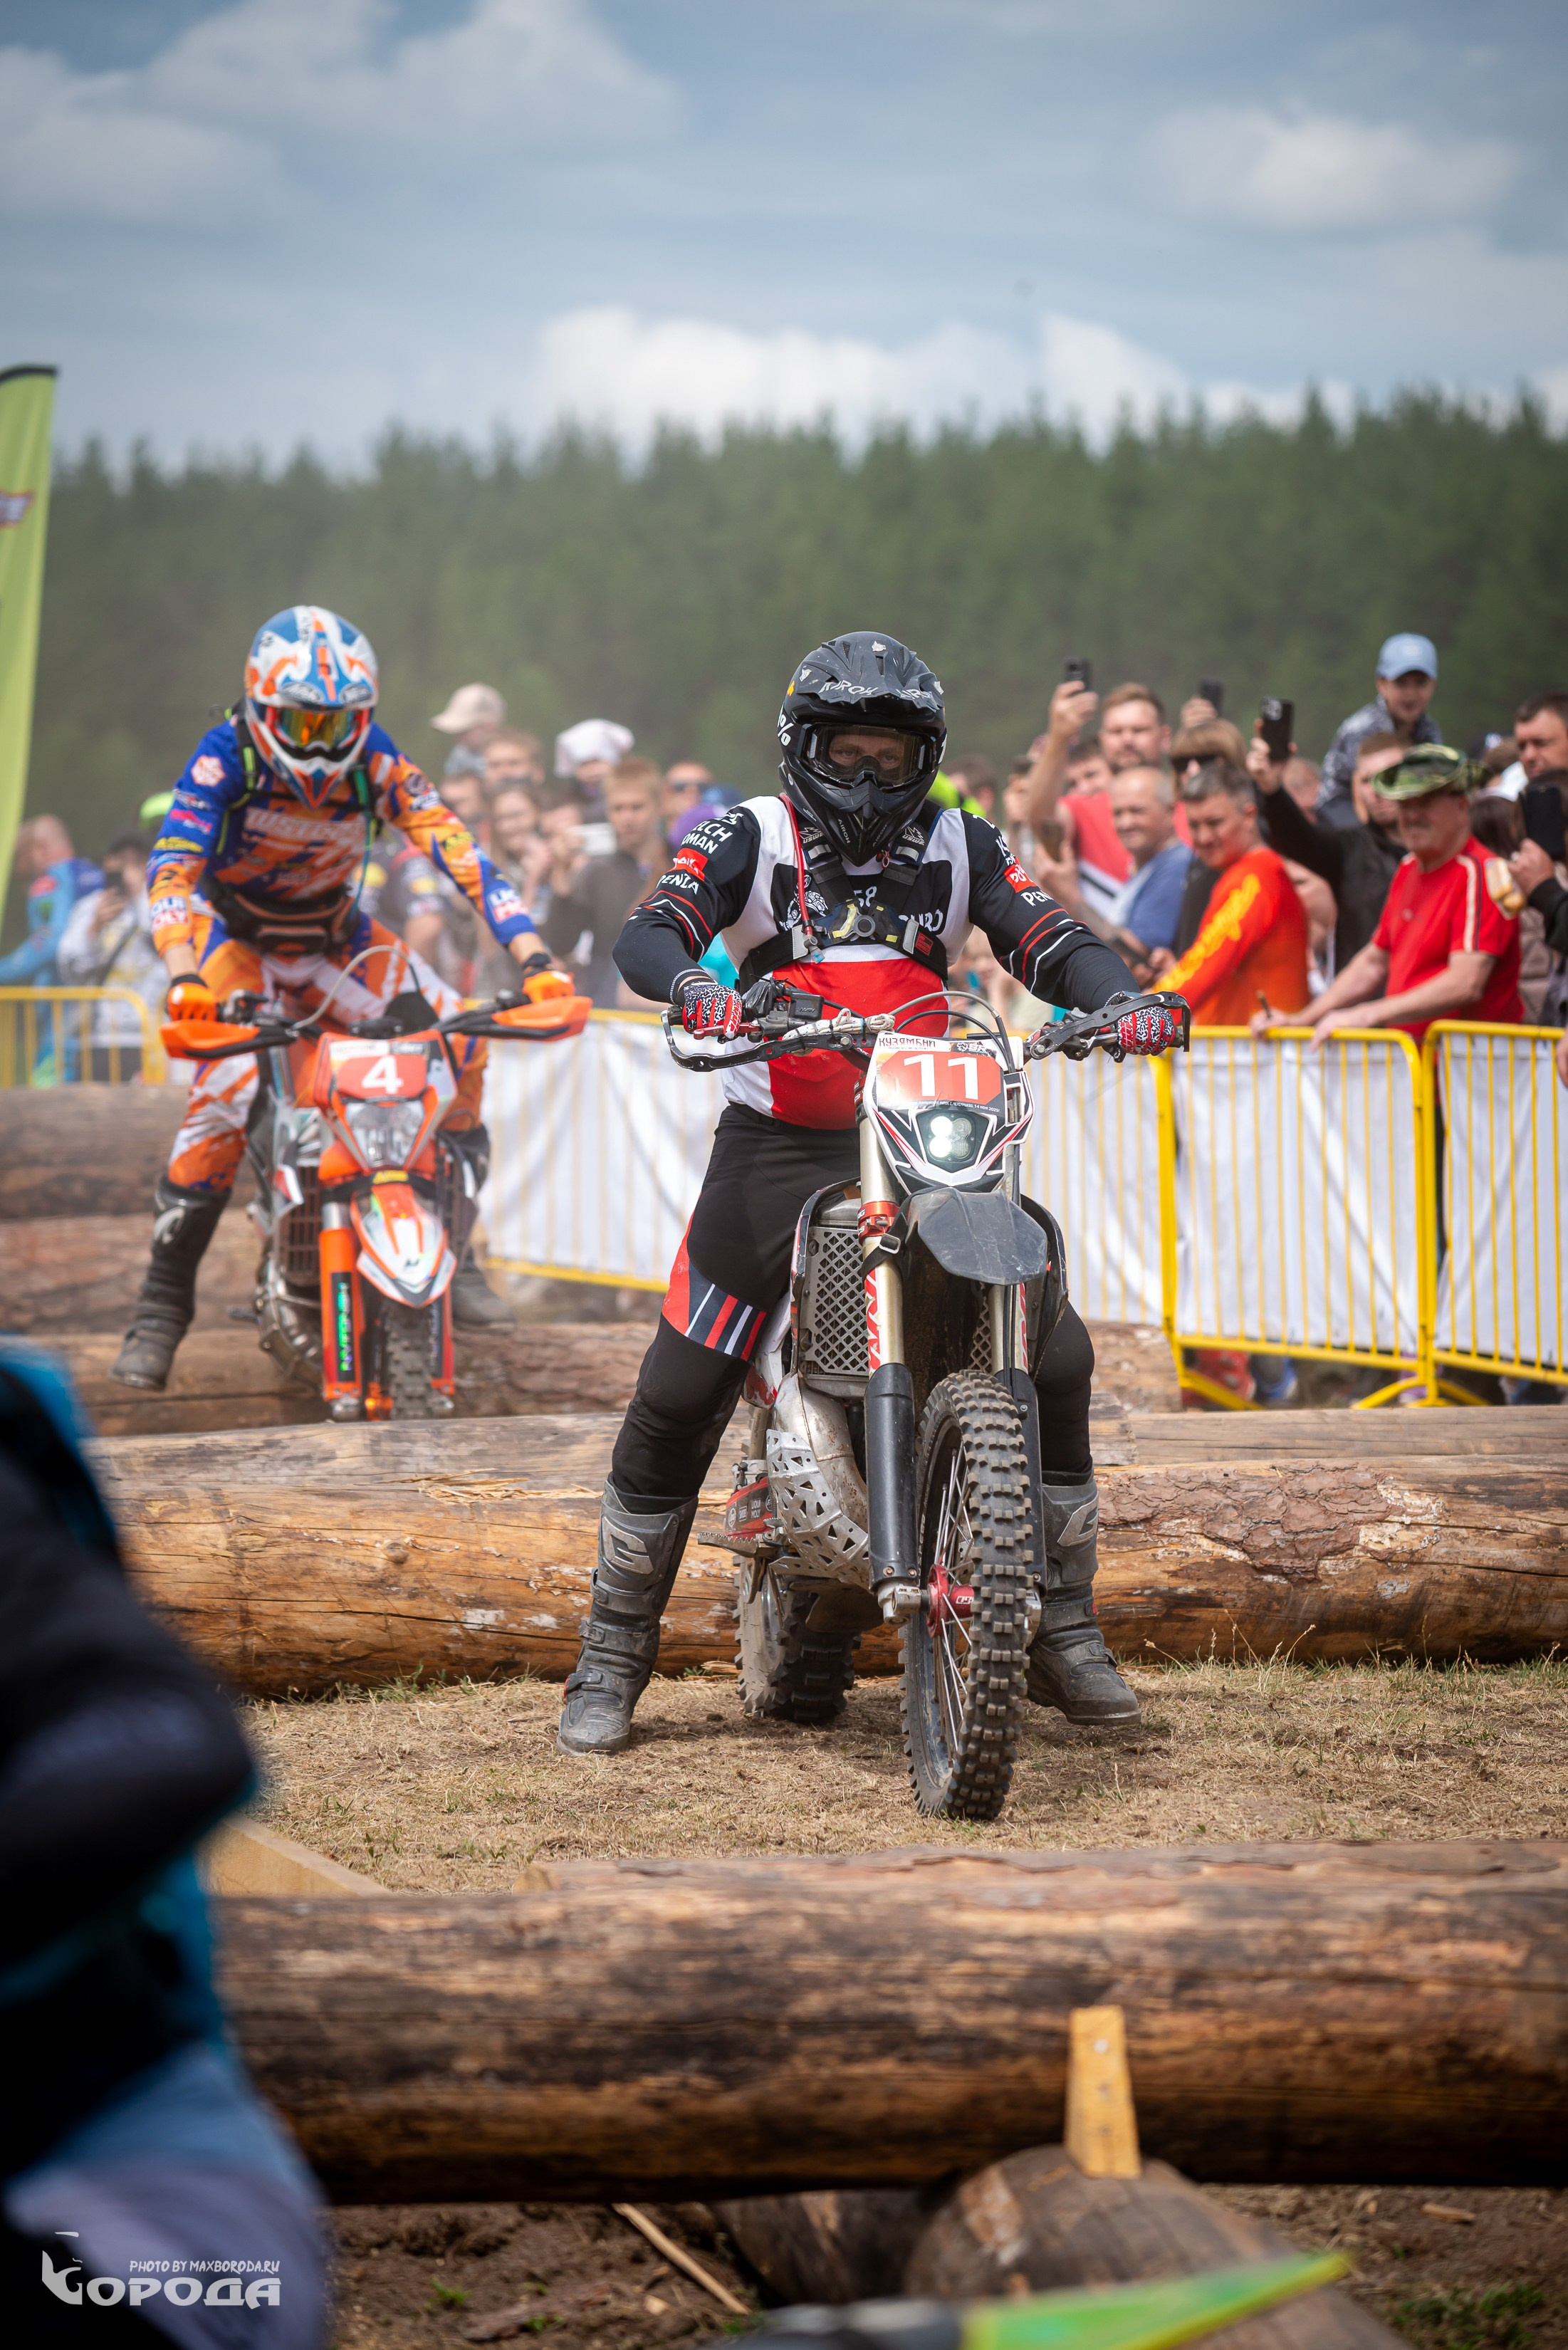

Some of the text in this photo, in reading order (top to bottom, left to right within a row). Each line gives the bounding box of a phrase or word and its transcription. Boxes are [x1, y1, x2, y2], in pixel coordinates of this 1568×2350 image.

[837, 818, 851, 844] AIROH
[681, 833, 719, 855] OMAN
[656, 873, 699, 895] PENZA
[1020, 890, 1055, 907] PEN
[361, 1055, 404, 1095] 4
[904, 1054, 978, 1100] 11
[751, 1499, 761, 1510] LIQUI
[751, 1509, 761, 1519] MOLY
